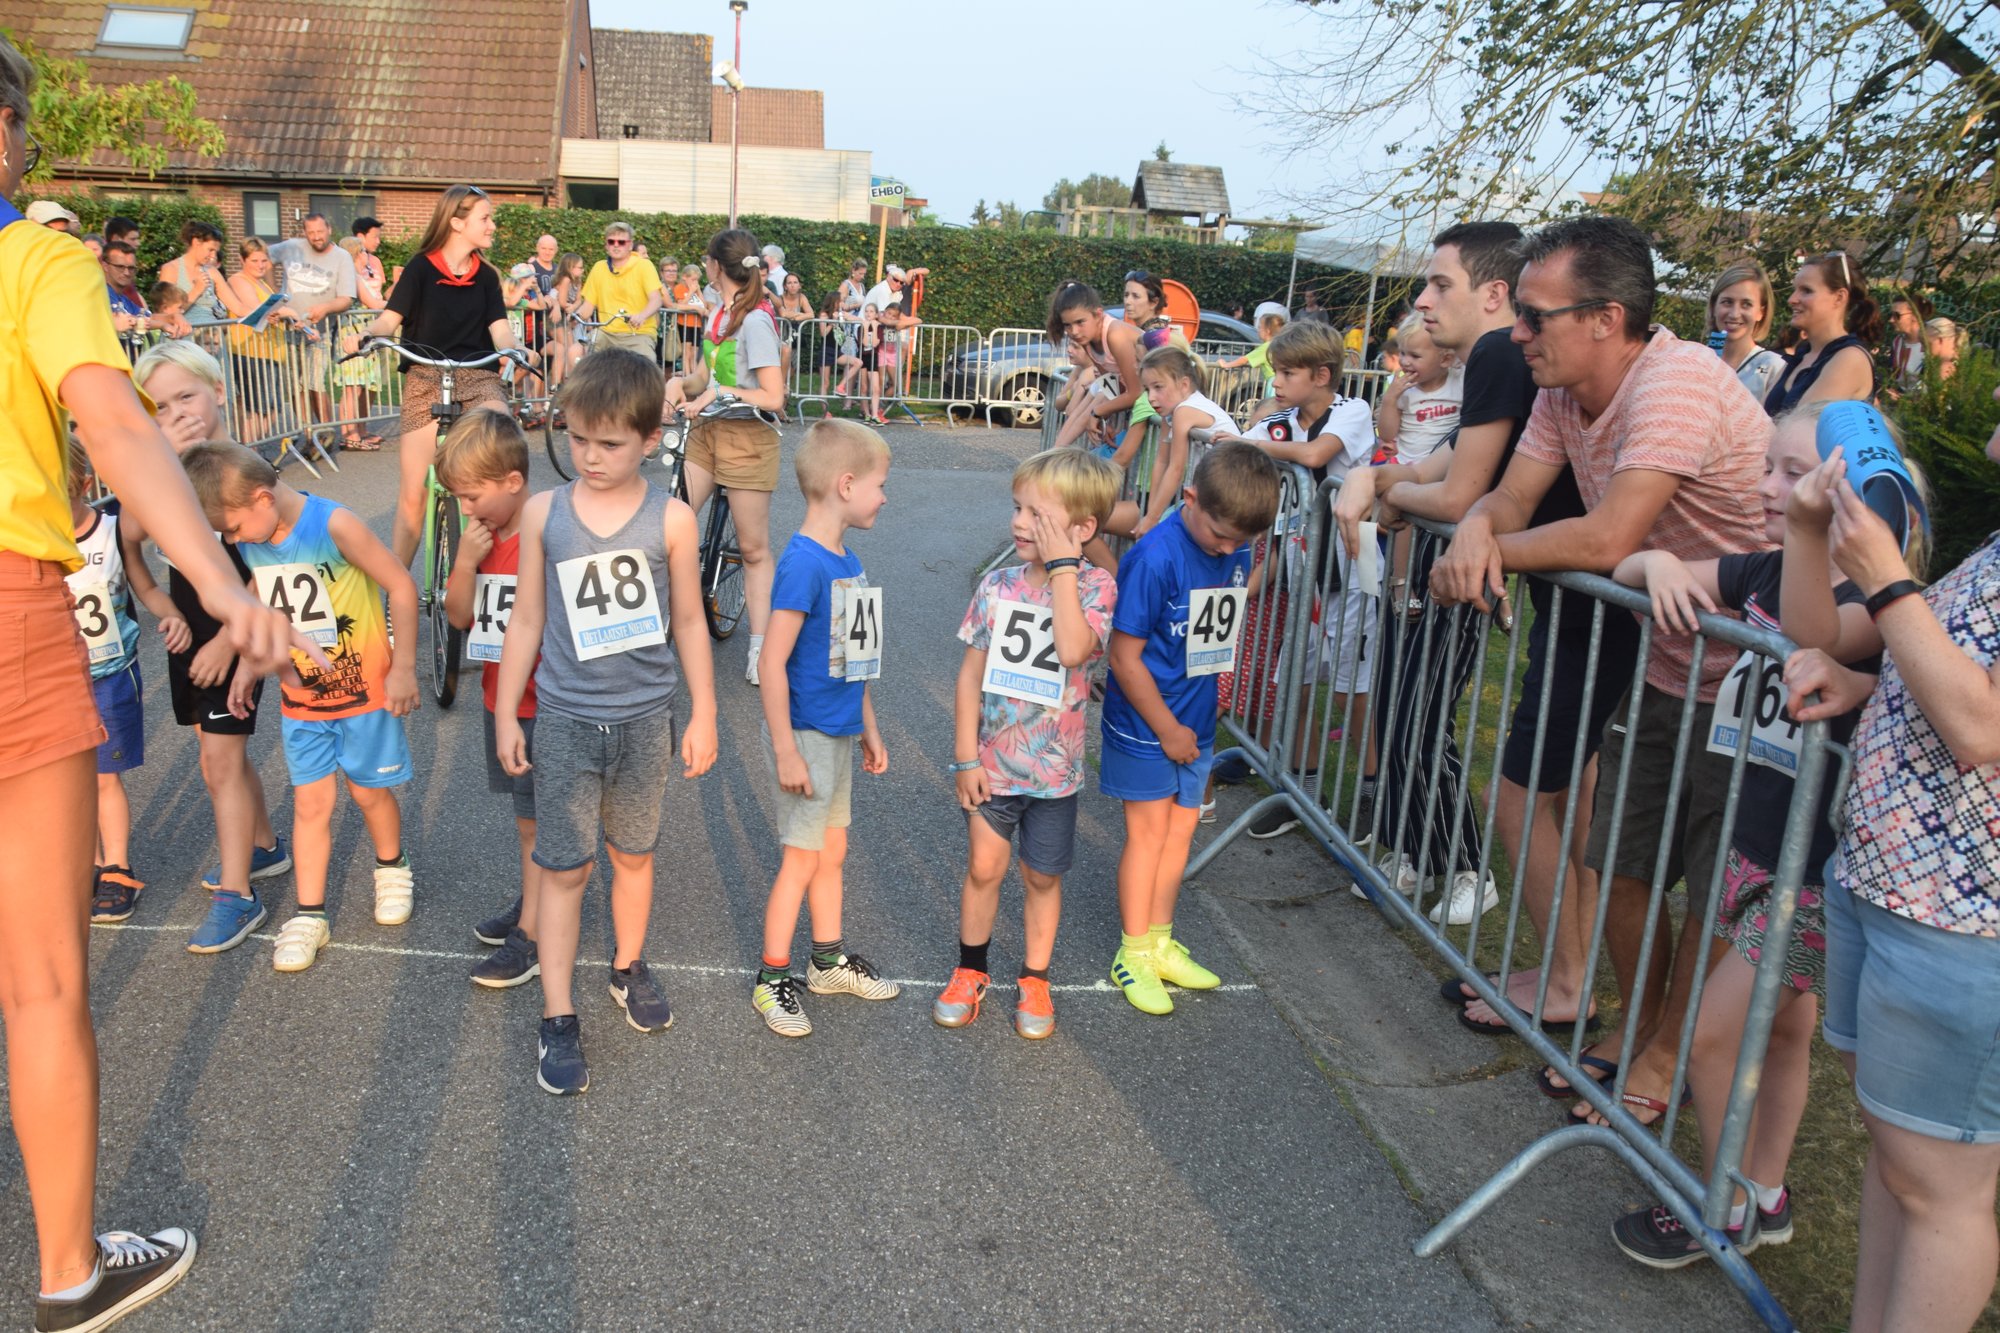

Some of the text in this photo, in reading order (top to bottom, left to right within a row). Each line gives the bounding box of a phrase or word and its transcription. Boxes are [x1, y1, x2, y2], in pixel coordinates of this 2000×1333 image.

[871, 185, 903, 198] EHBO
[269, 572, 328, 624] 42
[477, 583, 517, 634] 45
[575, 554, 647, 616] 48
[582, 619, 657, 646] HET LAATSTE NIEUWS
[849, 597, 878, 650] 41
[1000, 609, 1060, 673] 52
[1193, 594, 1237, 644] 49
[1718, 727, 1738, 746] HET
